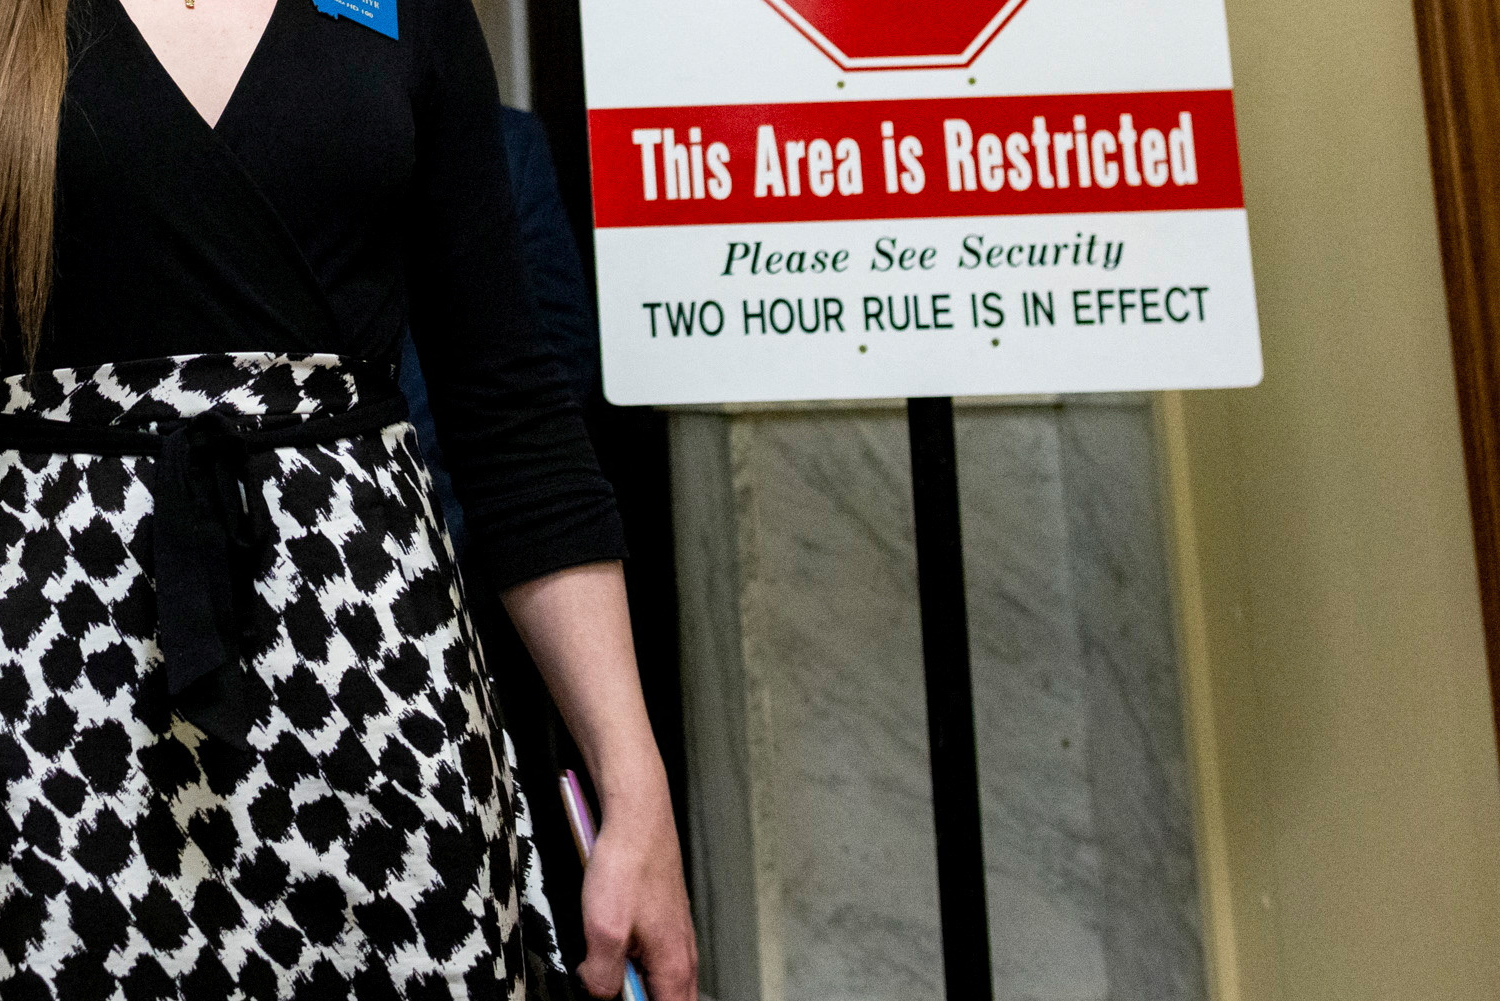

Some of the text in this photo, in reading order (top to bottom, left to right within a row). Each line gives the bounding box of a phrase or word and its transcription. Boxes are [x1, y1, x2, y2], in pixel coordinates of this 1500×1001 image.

[632, 110, 1199, 201] This Area is Restricted
[720, 232, 1126, 276] Please See Security
[642, 285, 1210, 339] TWO HOUR RULE IS IN EFFECT
